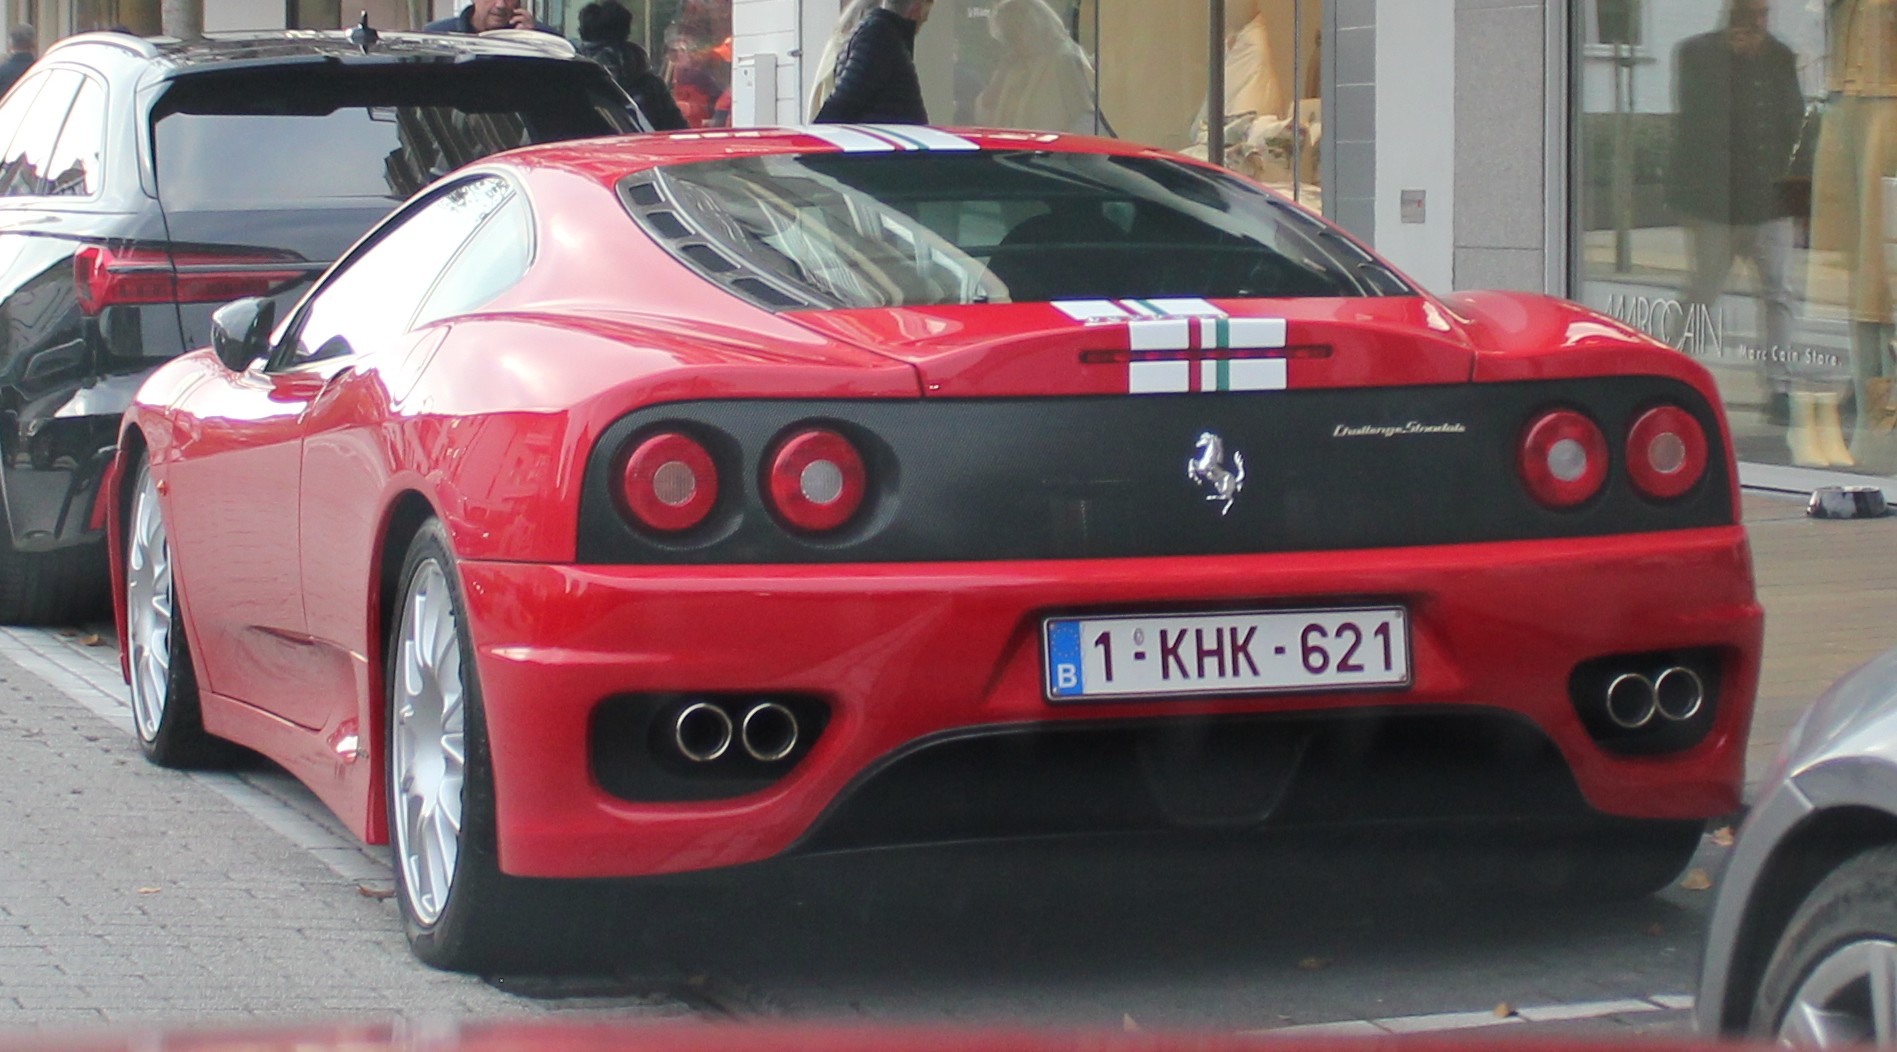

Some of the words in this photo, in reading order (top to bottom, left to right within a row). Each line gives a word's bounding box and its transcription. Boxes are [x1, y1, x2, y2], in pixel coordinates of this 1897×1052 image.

[1740, 344, 1768, 361] Marc
[1772, 345, 1799, 362] Cain
[1057, 663, 1078, 689] B
